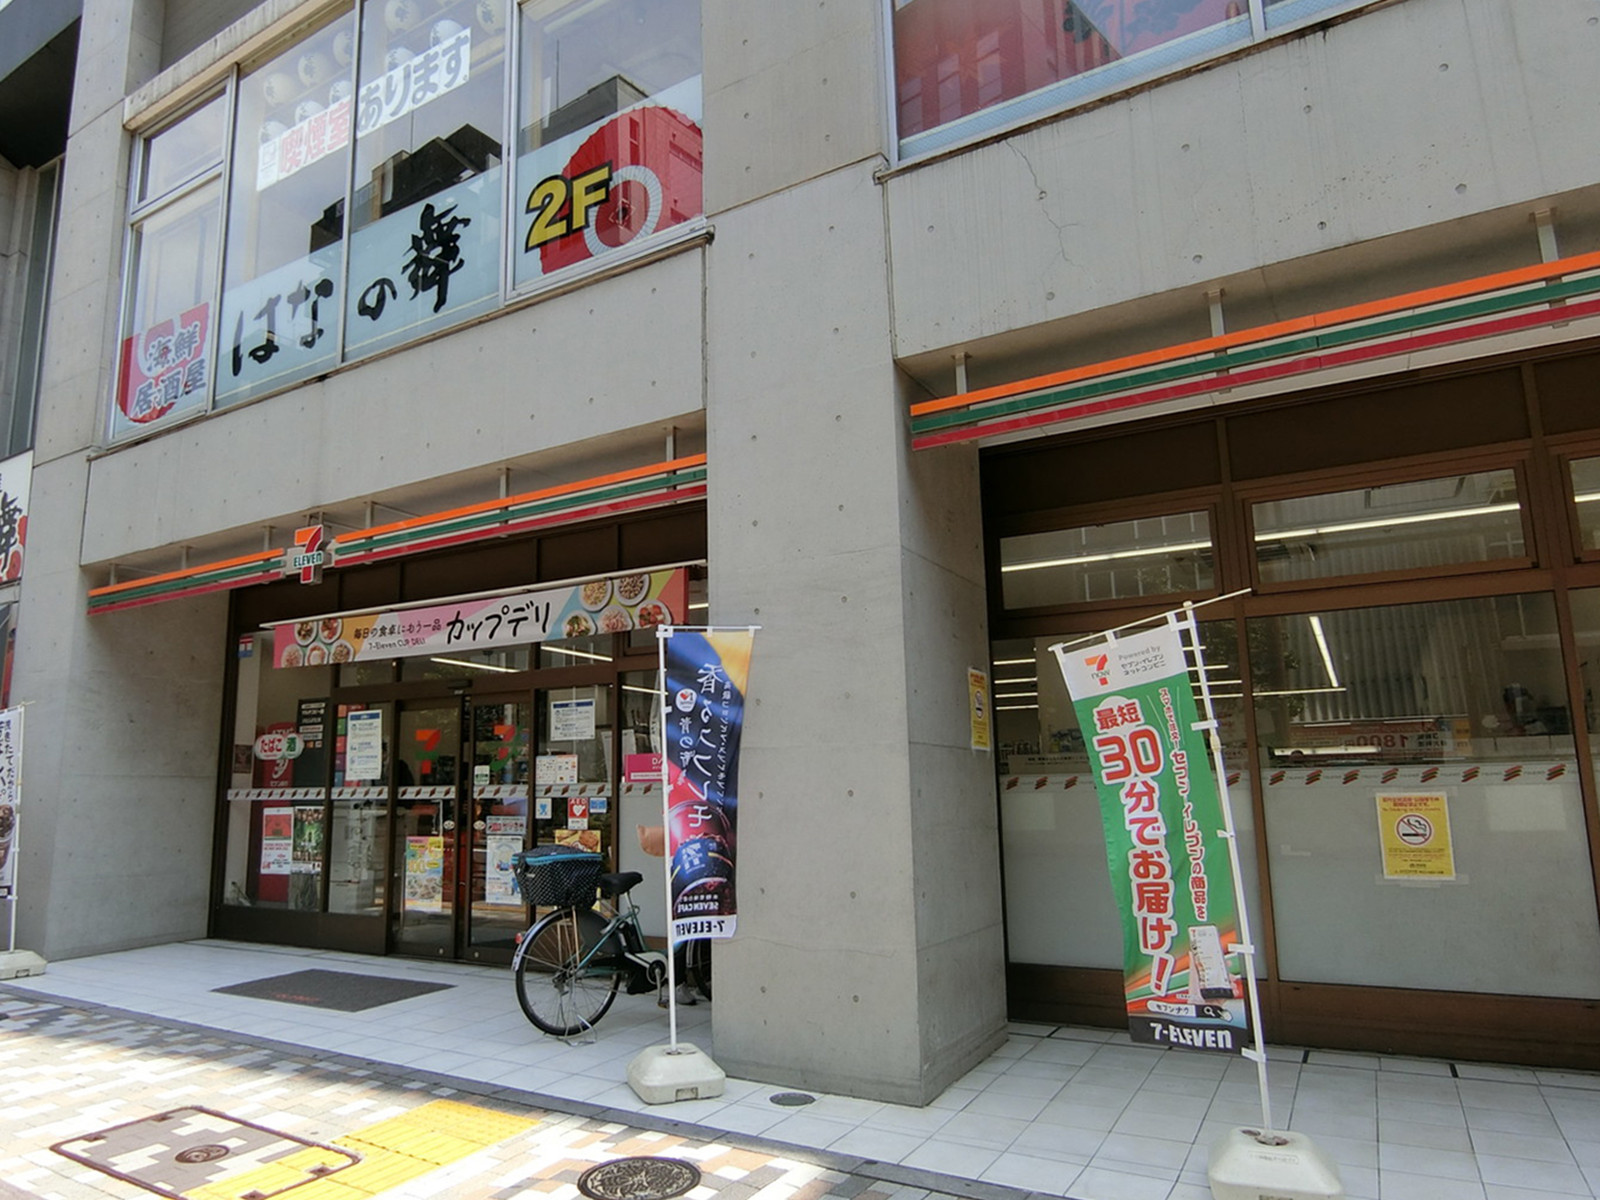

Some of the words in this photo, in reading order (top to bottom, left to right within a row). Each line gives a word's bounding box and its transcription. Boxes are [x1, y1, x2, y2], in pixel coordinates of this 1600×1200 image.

[525, 160, 612, 252] 2F
[233, 203, 471, 376] はなの舞
[147, 324, 199, 371] 海鮮
[131, 358, 206, 414] 居酒屋
[294, 524, 324, 584] 7
[353, 618, 442, 640] 毎日の食卓にもう一品
[446, 599, 551, 645] カップデリ
[1118, 648, 1151, 660] Powered
[1151, 645, 1161, 654] by
[1123, 660, 1167, 676] ネットコンビニ
[1096, 701, 1141, 730] 最短
[260, 738, 283, 753] たばこ
